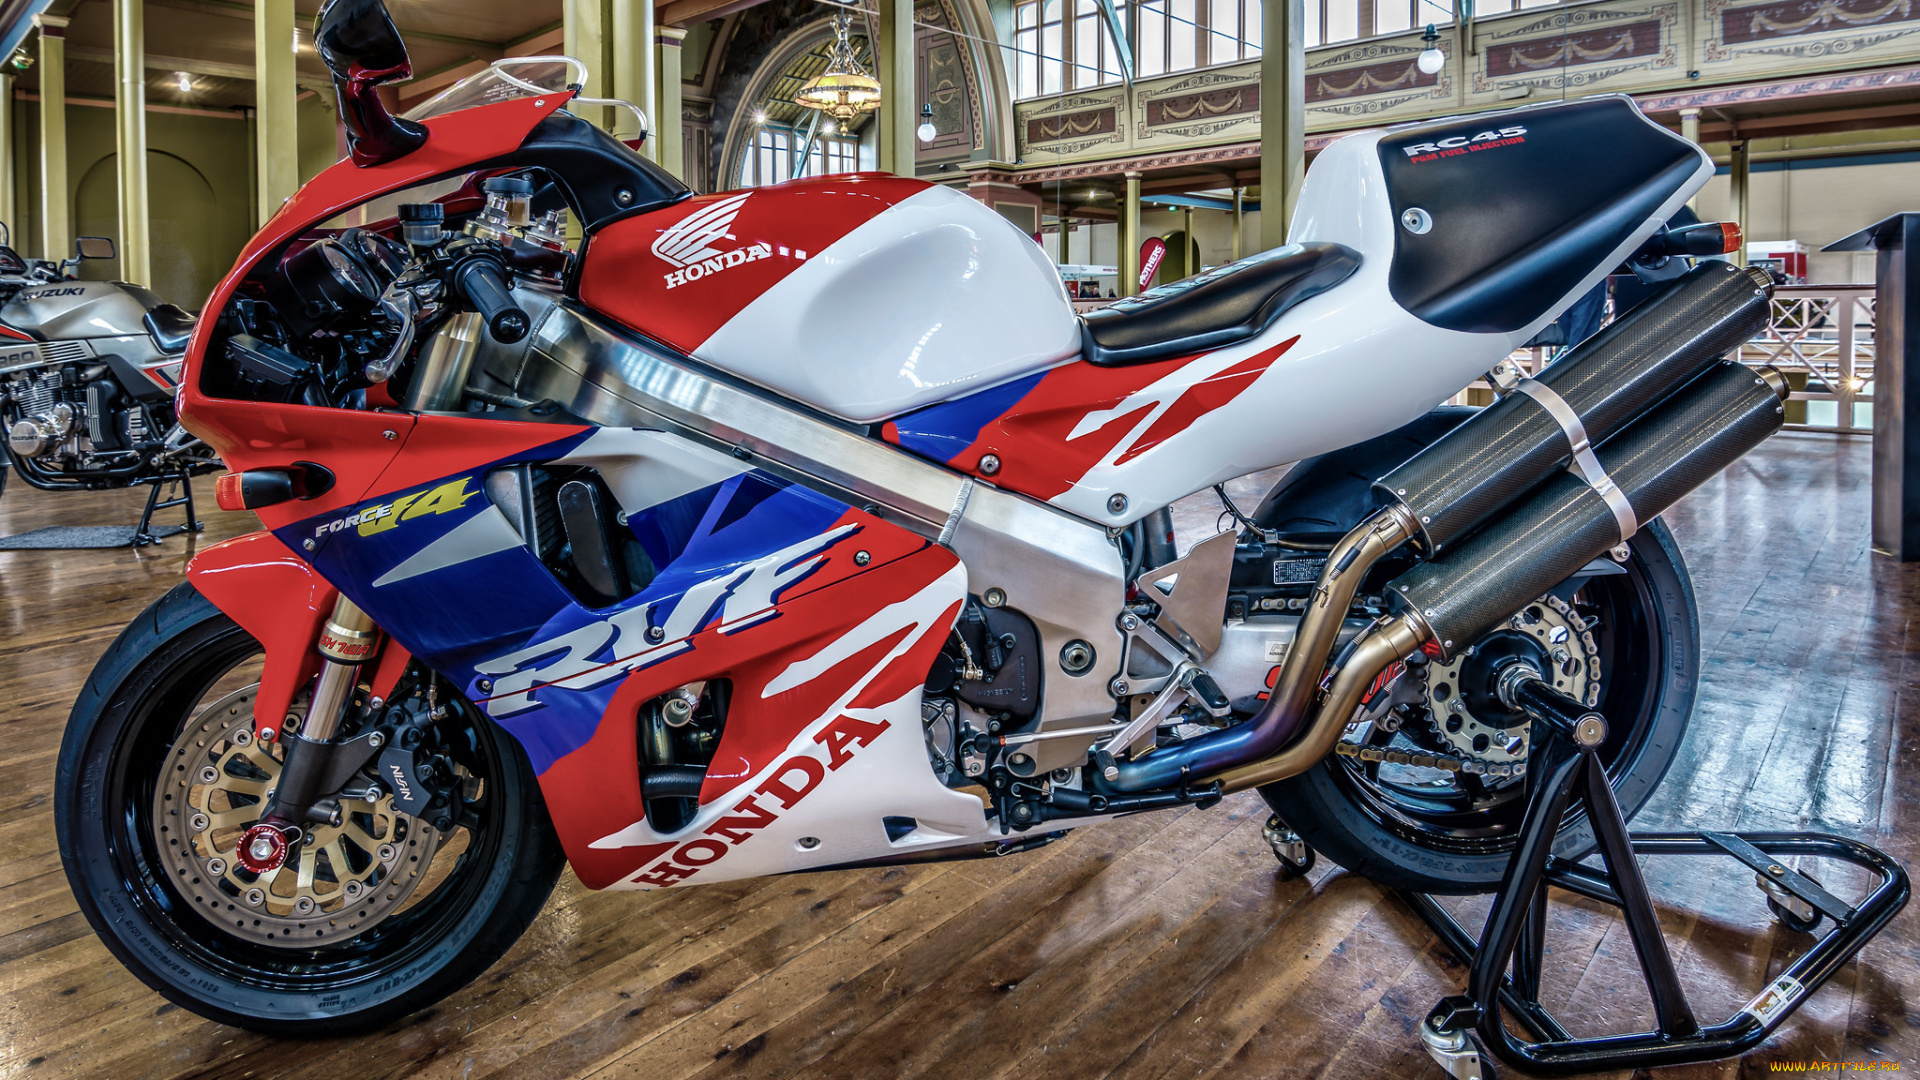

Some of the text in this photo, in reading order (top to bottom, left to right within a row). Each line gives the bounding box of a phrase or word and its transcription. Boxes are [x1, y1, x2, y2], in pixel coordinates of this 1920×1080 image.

[1403, 126, 1528, 157] RC45
[1411, 136, 1525, 164] PGM FUEL INJECTION
[663, 243, 773, 290] HONDA
[1140, 244, 1163, 286] MOTHERS
[26, 287, 86, 300] SUZUKI
[315, 503, 394, 538] FORCE
[357, 475, 480, 537] V4
[473, 521, 861, 718] RVF
[390, 764, 414, 801] NISSIN
[630, 713, 892, 888] HONDA
